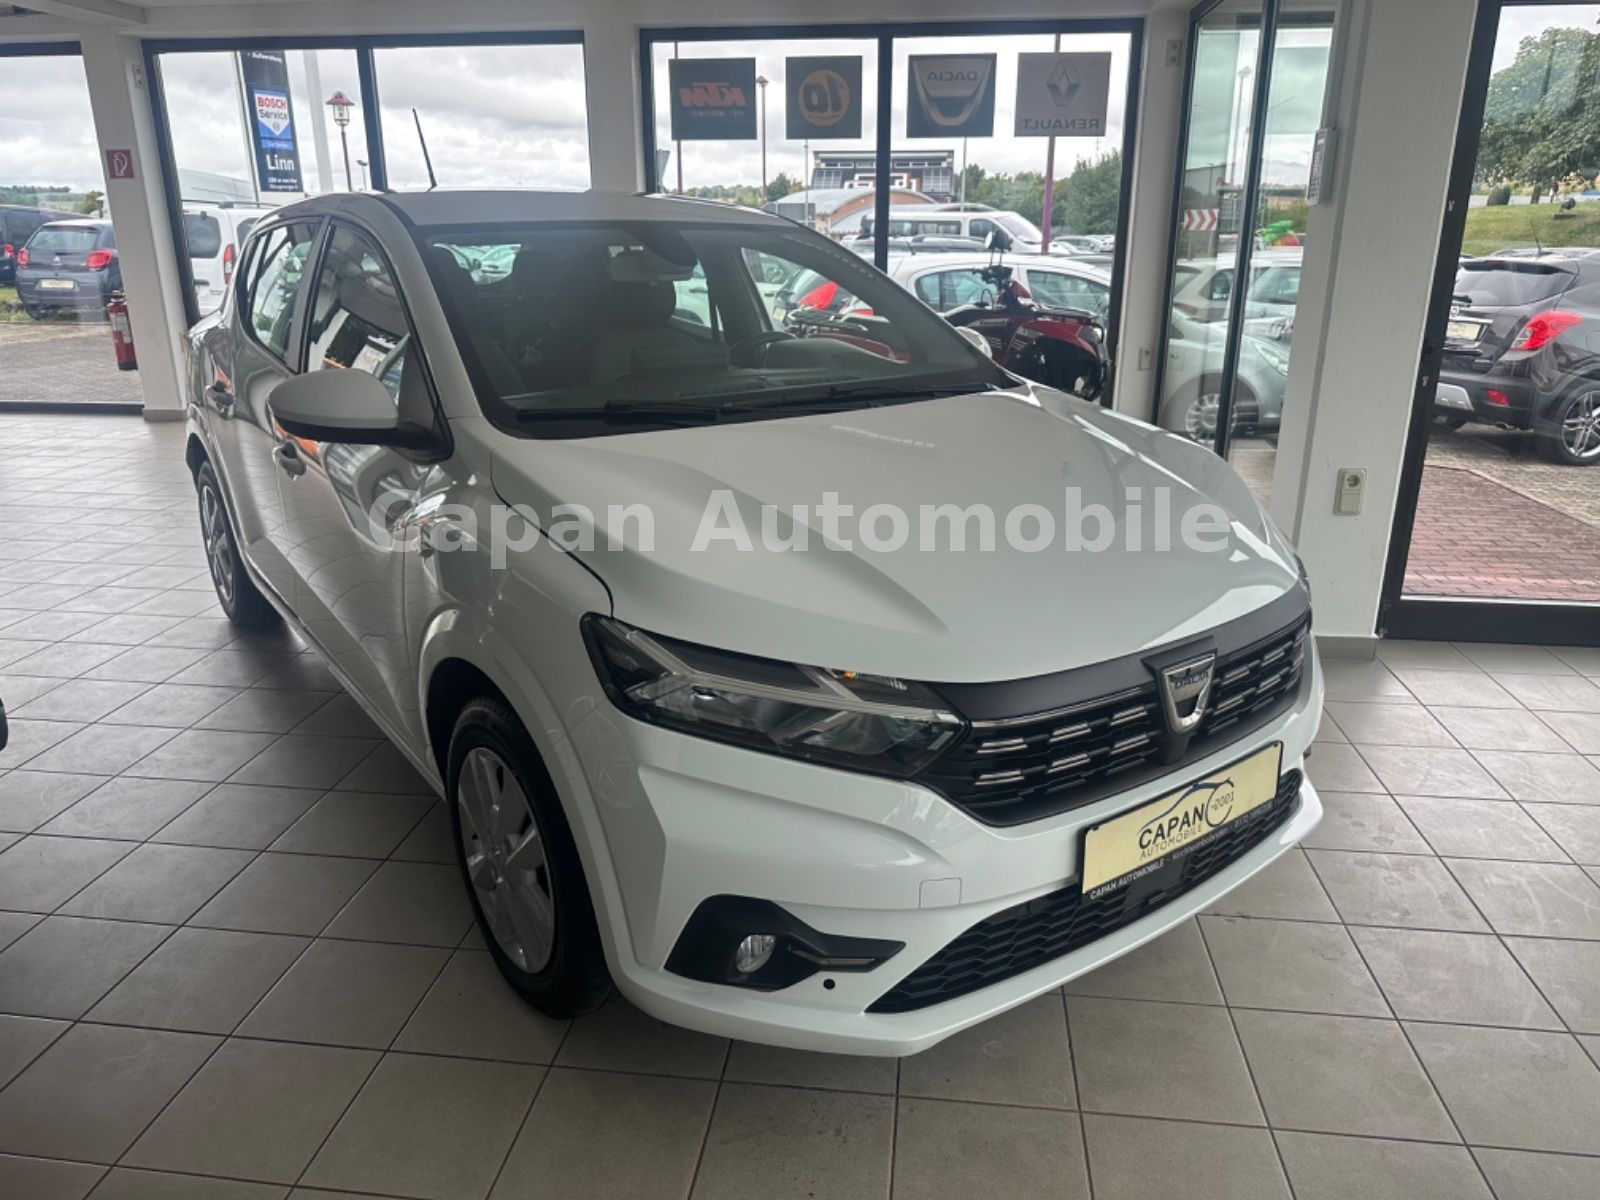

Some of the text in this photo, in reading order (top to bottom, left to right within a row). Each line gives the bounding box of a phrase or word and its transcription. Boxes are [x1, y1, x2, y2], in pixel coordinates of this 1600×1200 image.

[257, 96, 287, 109] BOSCH
[266, 154, 294, 170] Linn
[1138, 803, 1205, 849] CAPAN
[1140, 824, 1202, 860] AUTOMOBILE
[1090, 880, 1117, 899] CAPAN
